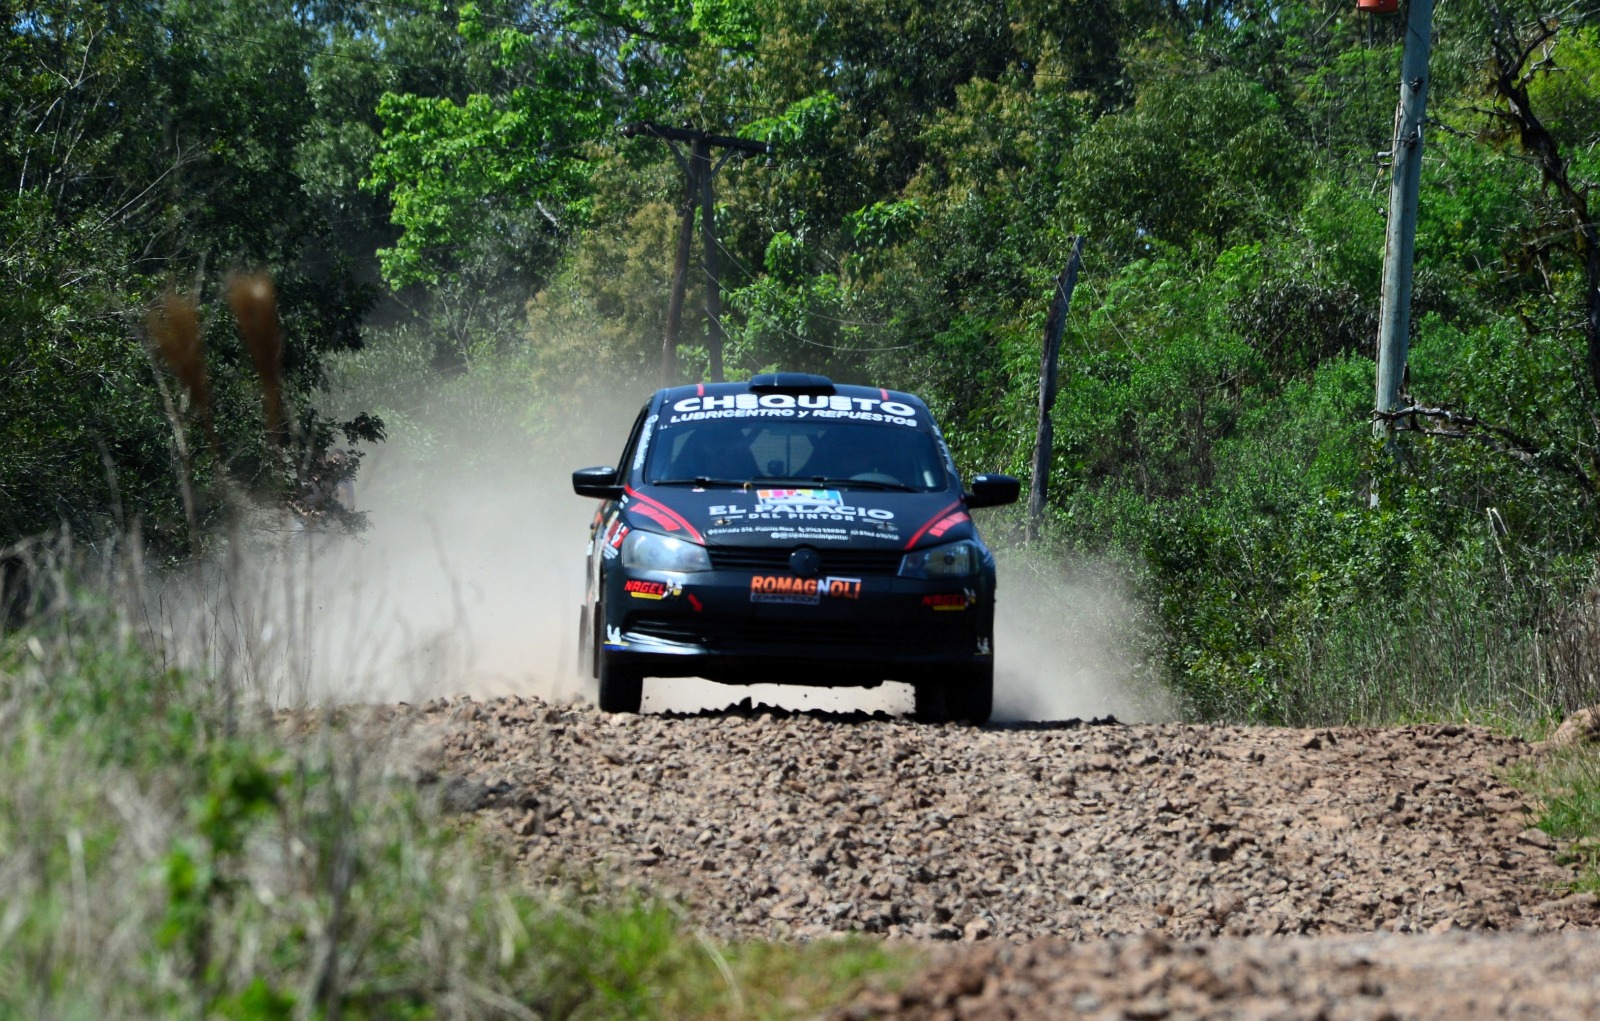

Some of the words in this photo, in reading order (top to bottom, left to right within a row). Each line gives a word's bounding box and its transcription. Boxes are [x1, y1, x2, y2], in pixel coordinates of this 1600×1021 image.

[670, 408, 795, 423] LUBRICENTRO
[812, 409, 918, 427] REPUESTOS
[708, 505, 747, 516] EL
[754, 504, 895, 520] PALACIO
[790, 513, 855, 522] PINTOR
[623, 579, 665, 595] NAGEL
[751, 575, 862, 599] ROMAGNOLI
